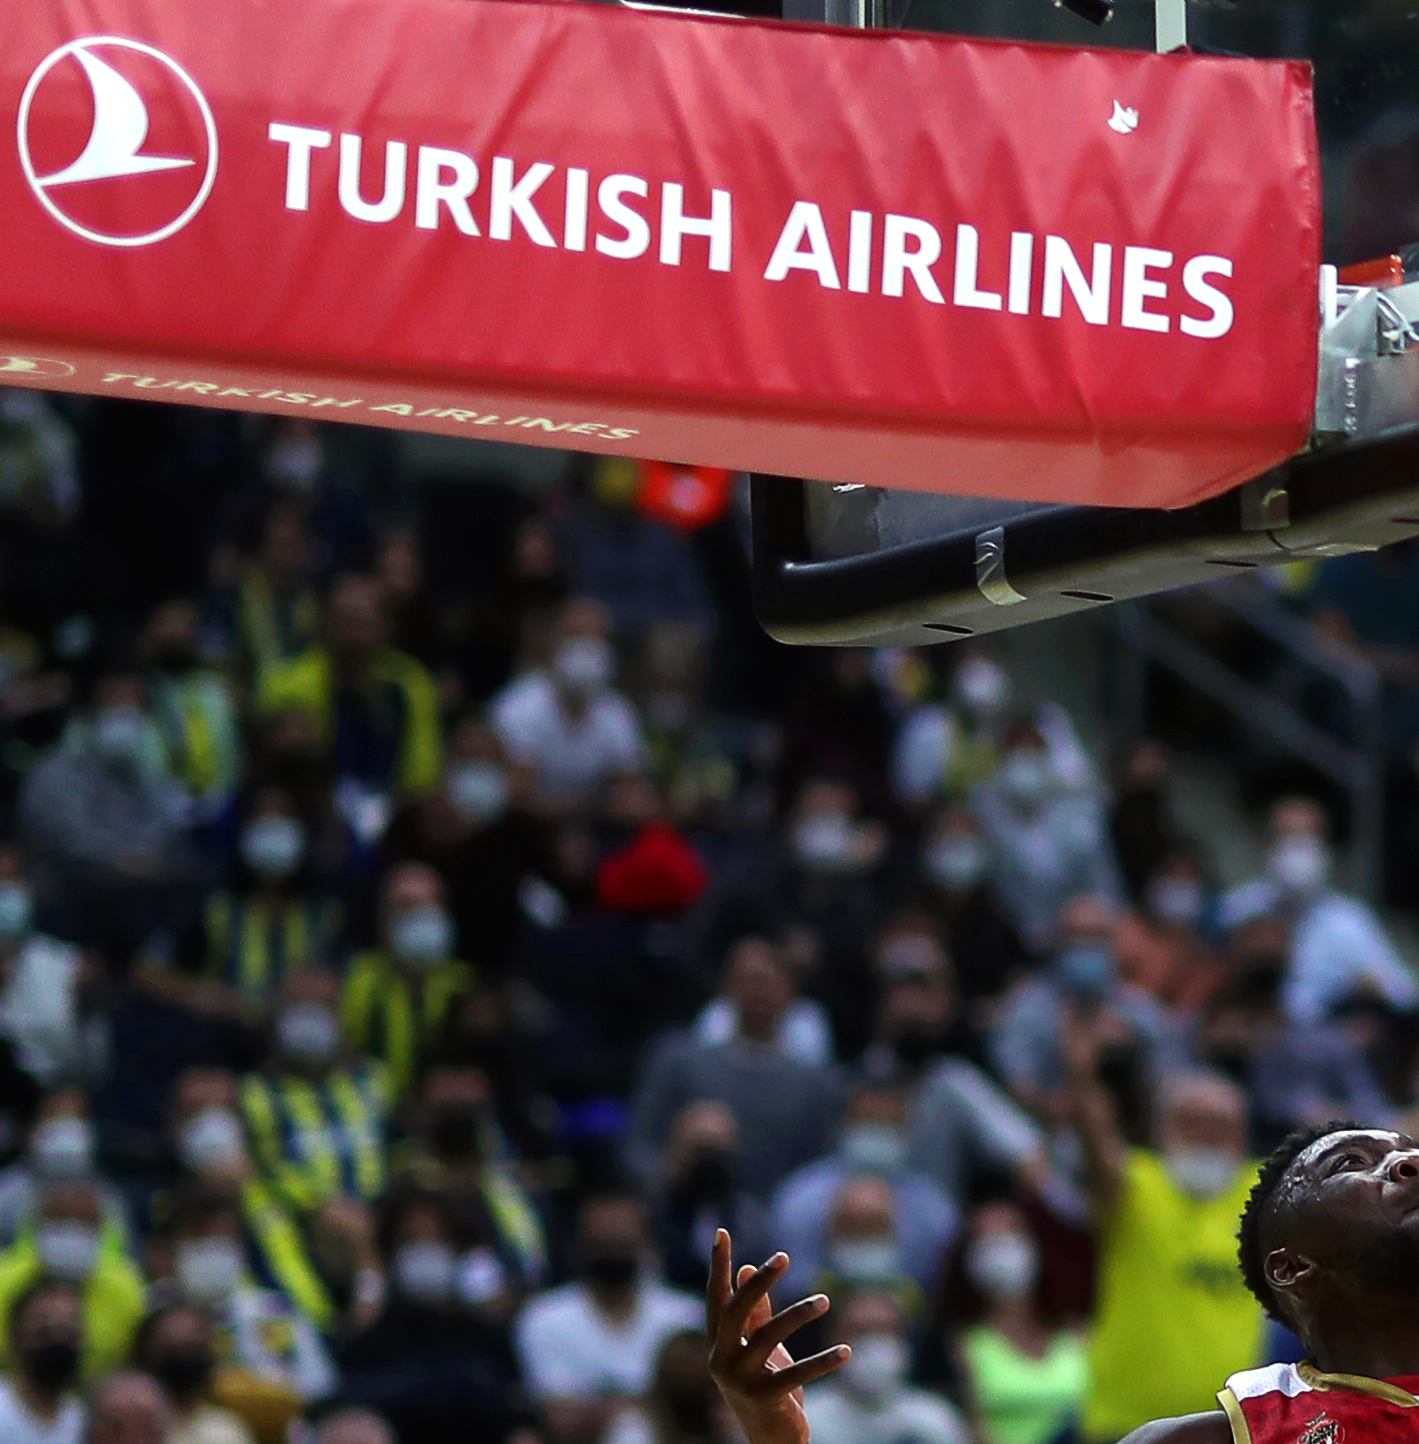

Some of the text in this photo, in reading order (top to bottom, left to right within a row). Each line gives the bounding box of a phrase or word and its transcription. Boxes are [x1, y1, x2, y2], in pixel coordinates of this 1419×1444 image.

[268, 122, 1234, 339] TURKISH AIRLINES
[100, 372, 640, 442] TURKISH AIRLINES
